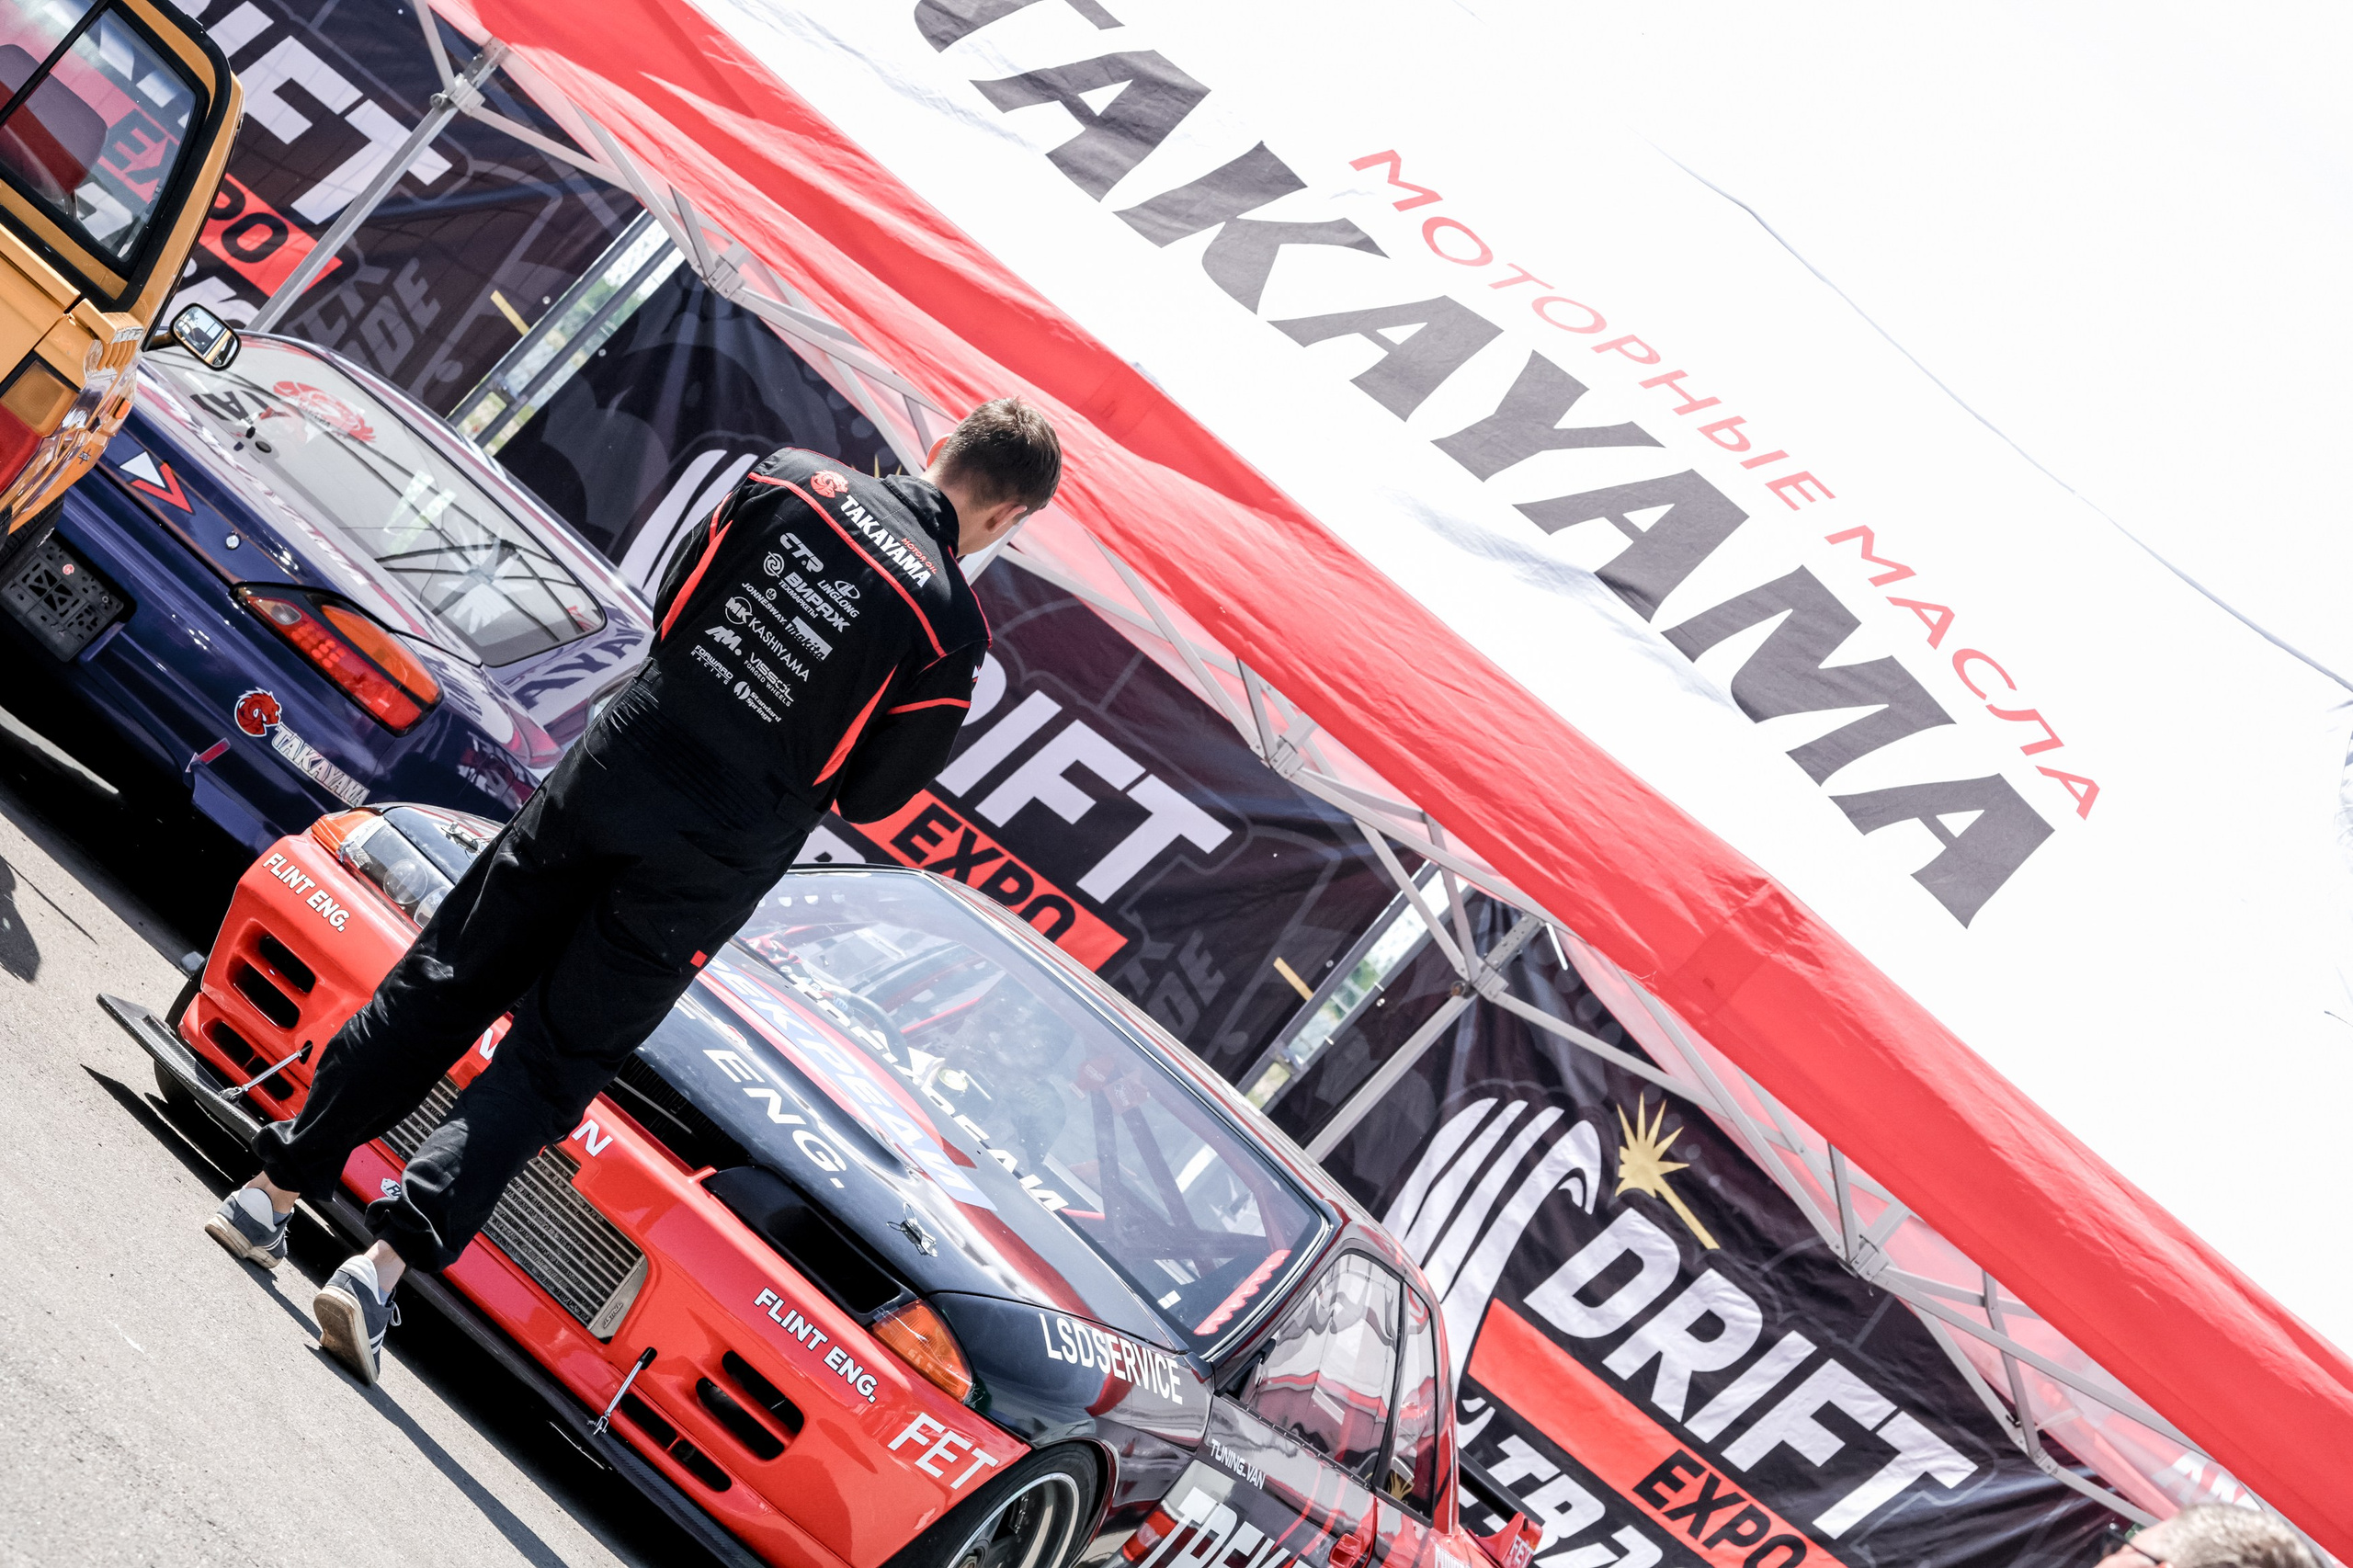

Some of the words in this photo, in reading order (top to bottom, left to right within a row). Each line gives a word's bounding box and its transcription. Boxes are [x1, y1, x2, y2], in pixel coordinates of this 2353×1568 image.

[1348, 150, 1836, 511] МОТОРНЫЕ
[1824, 525, 2100, 820] МАСЛА
[779, 530, 824, 573] CTR
[840, 494, 932, 588] TAKAYAMA
[900, 536, 927, 562] MOTOR
[924, 560, 938, 574] OIL
[778, 578, 818, 619] ТЕХМАРКЕТЫ
[783, 571, 850, 633] ВИРАЖ
[816, 578, 860, 619] LINGLONG
[689, 650, 729, 686] RACING
[694, 643, 734, 680] FORWARD
[724, 596, 753, 623] MK
[747, 616, 810, 682] KASHIYAMA
[743, 660, 766, 683] FORGED
[765, 681, 791, 707] WHEELS
[269, 722, 370, 808] TAKAYAMA
[262, 853, 315, 897] FLINT
[305, 888, 347, 931] ENG.
[703, 1048, 847, 1189] ENG.
[753, 1288, 828, 1351] FLINT
[824, 1346, 880, 1403] ENG.
[1039, 1313, 1184, 1405] LSDSERVICE
[1523, 1208, 1979, 1540] DRIFT
[887, 1412, 999, 1490] FET
